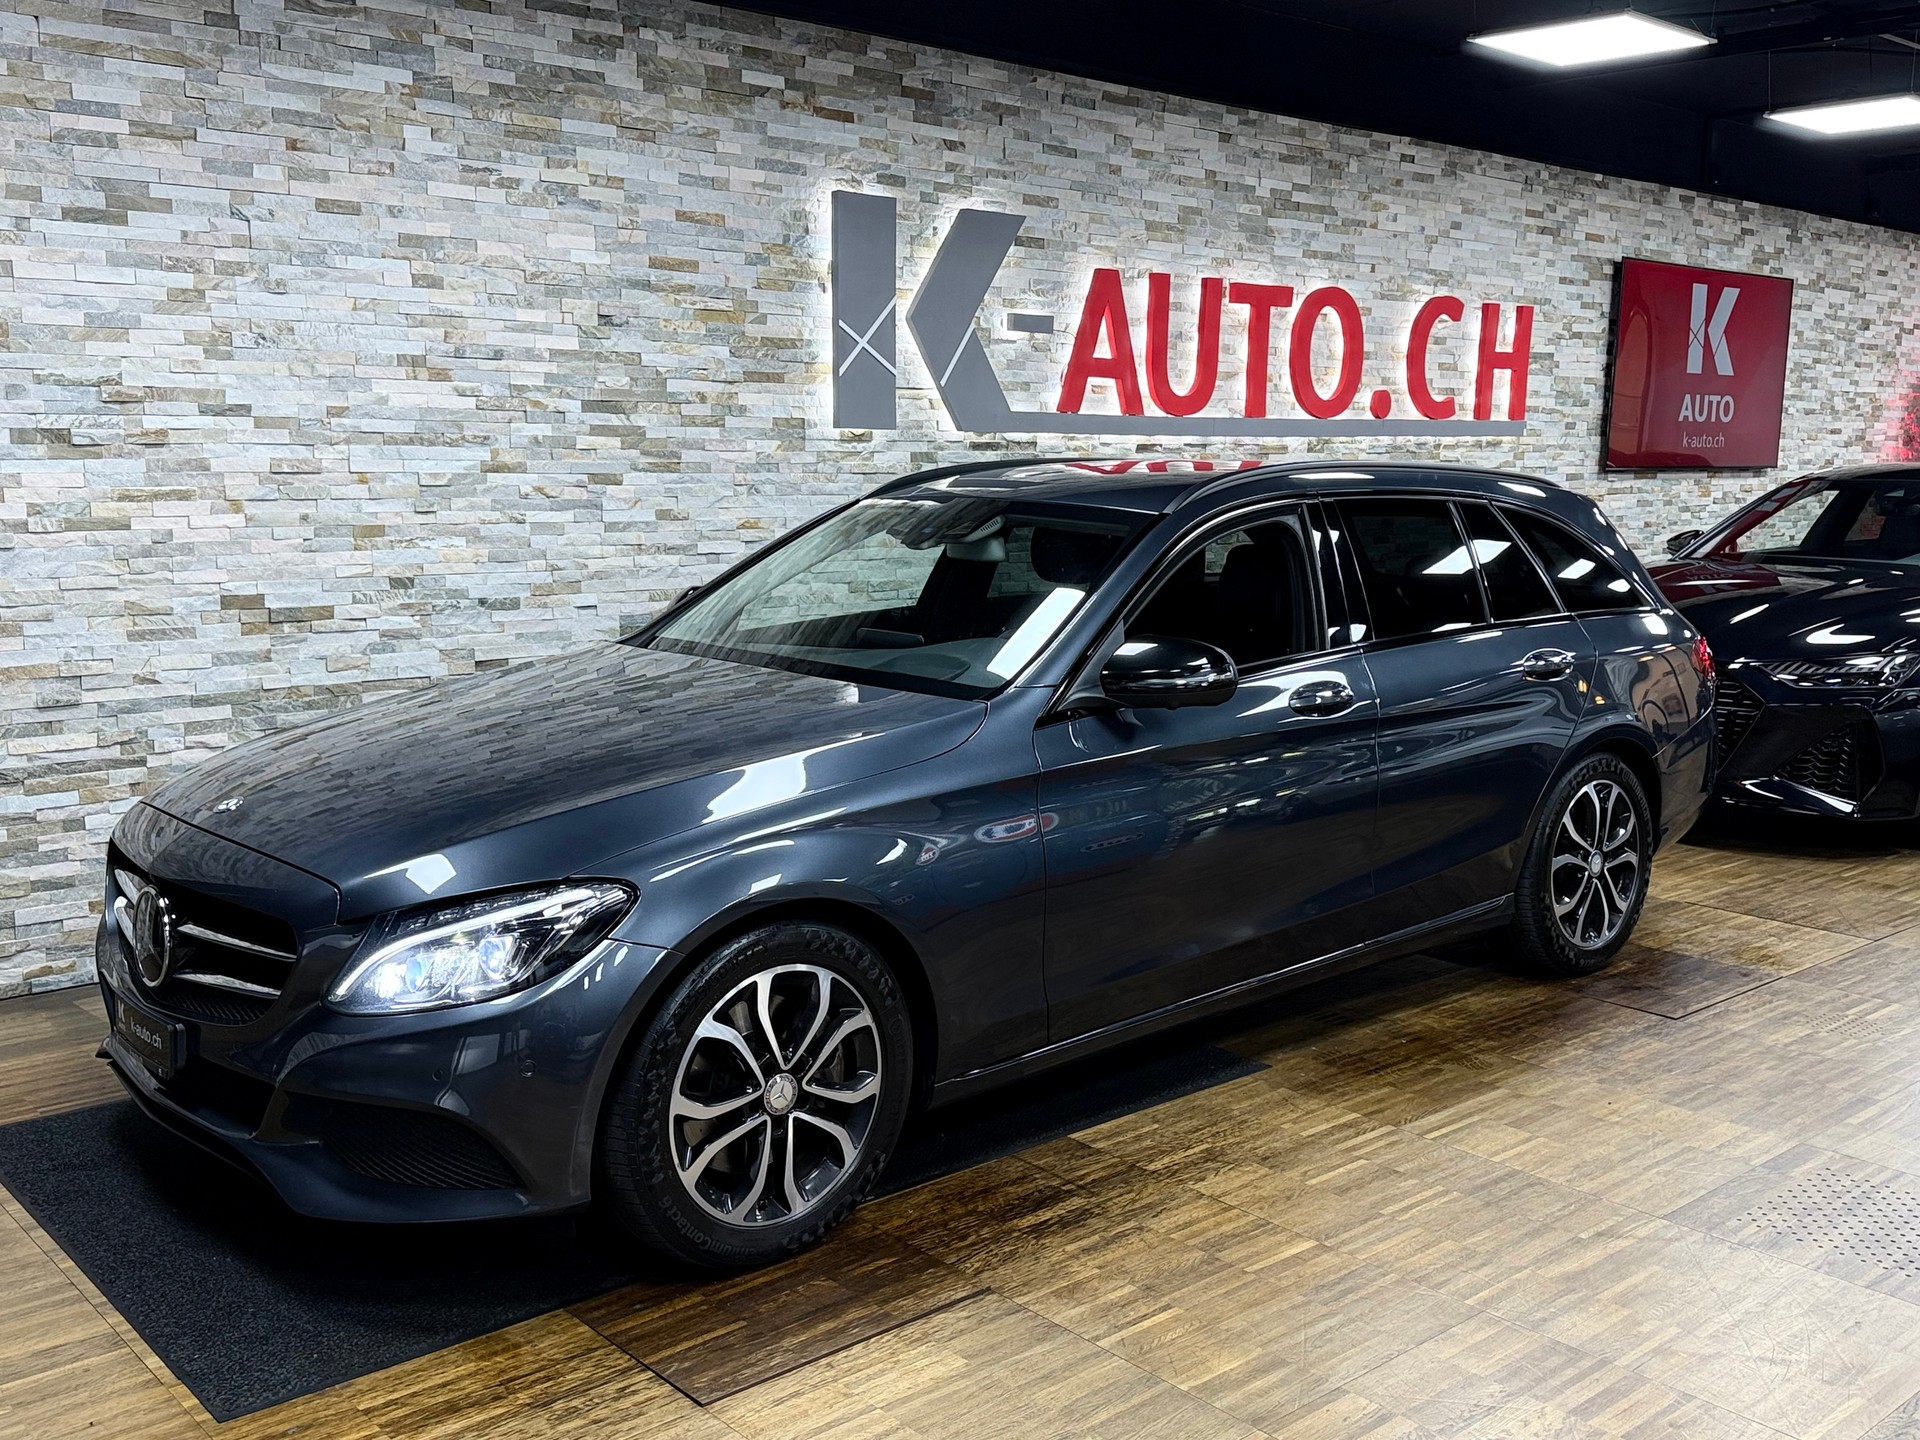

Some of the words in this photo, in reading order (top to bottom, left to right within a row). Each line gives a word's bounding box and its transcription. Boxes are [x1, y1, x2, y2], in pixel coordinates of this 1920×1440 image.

[831, 190, 1532, 434] K-AUTO.CH
[1686, 282, 1741, 376] K
[1678, 393, 1735, 423] AUTO
[1682, 431, 1725, 448] k-auto.ch
[130, 1016, 162, 1050] k-auto.ch
[666, 1204, 757, 1256] emiumContact
